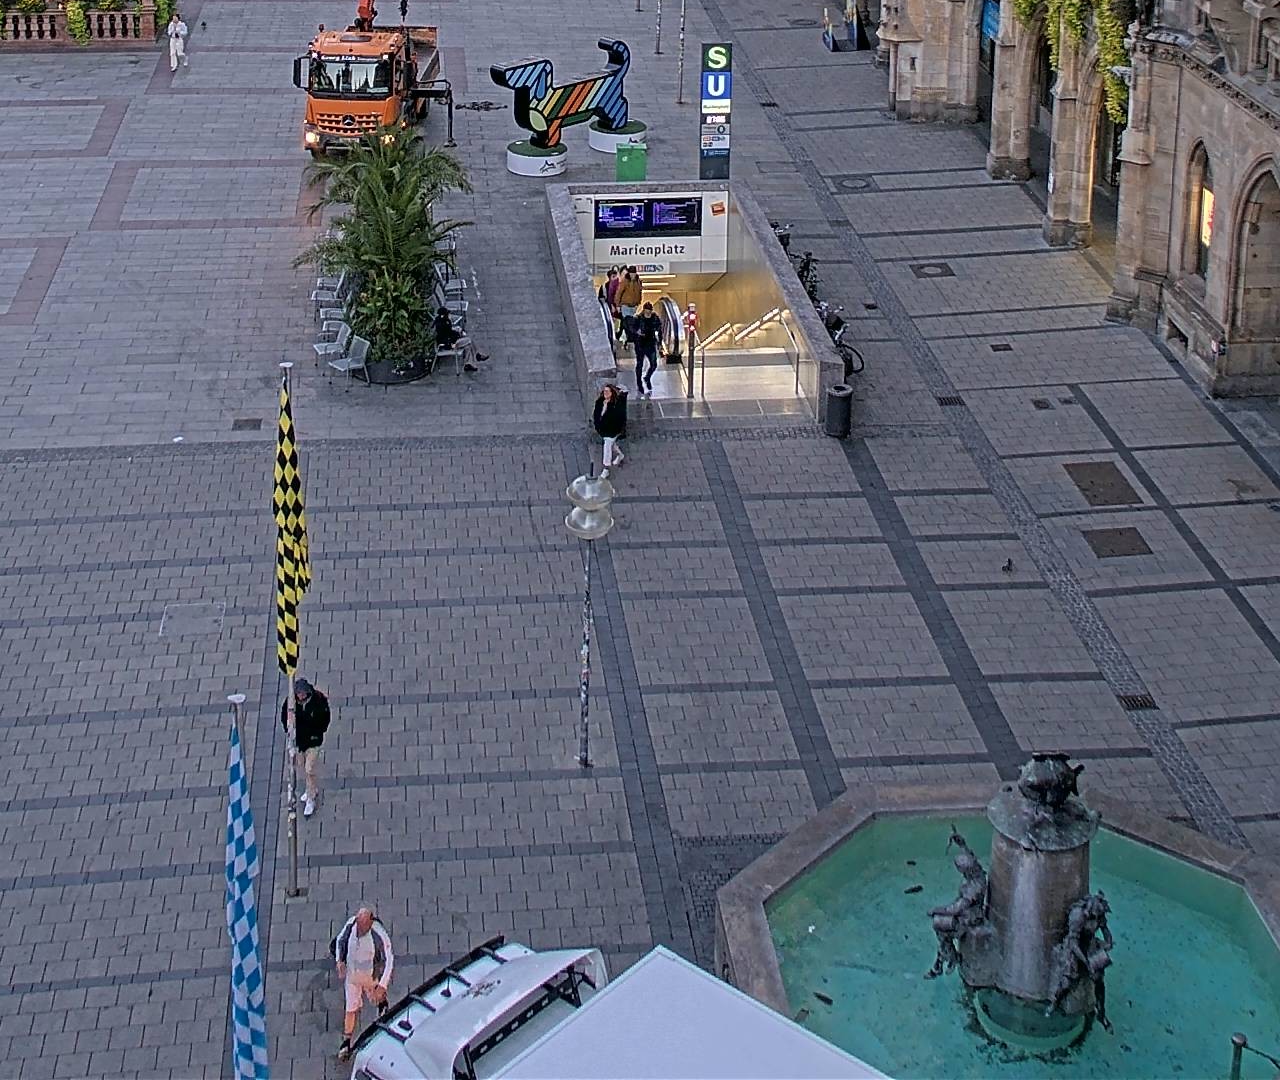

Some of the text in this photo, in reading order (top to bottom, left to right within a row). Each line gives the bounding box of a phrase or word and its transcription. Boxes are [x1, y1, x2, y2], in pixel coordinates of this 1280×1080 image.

[708, 46, 727, 69] S
[707, 75, 725, 96] U
[610, 243, 686, 257] Marienplatz
